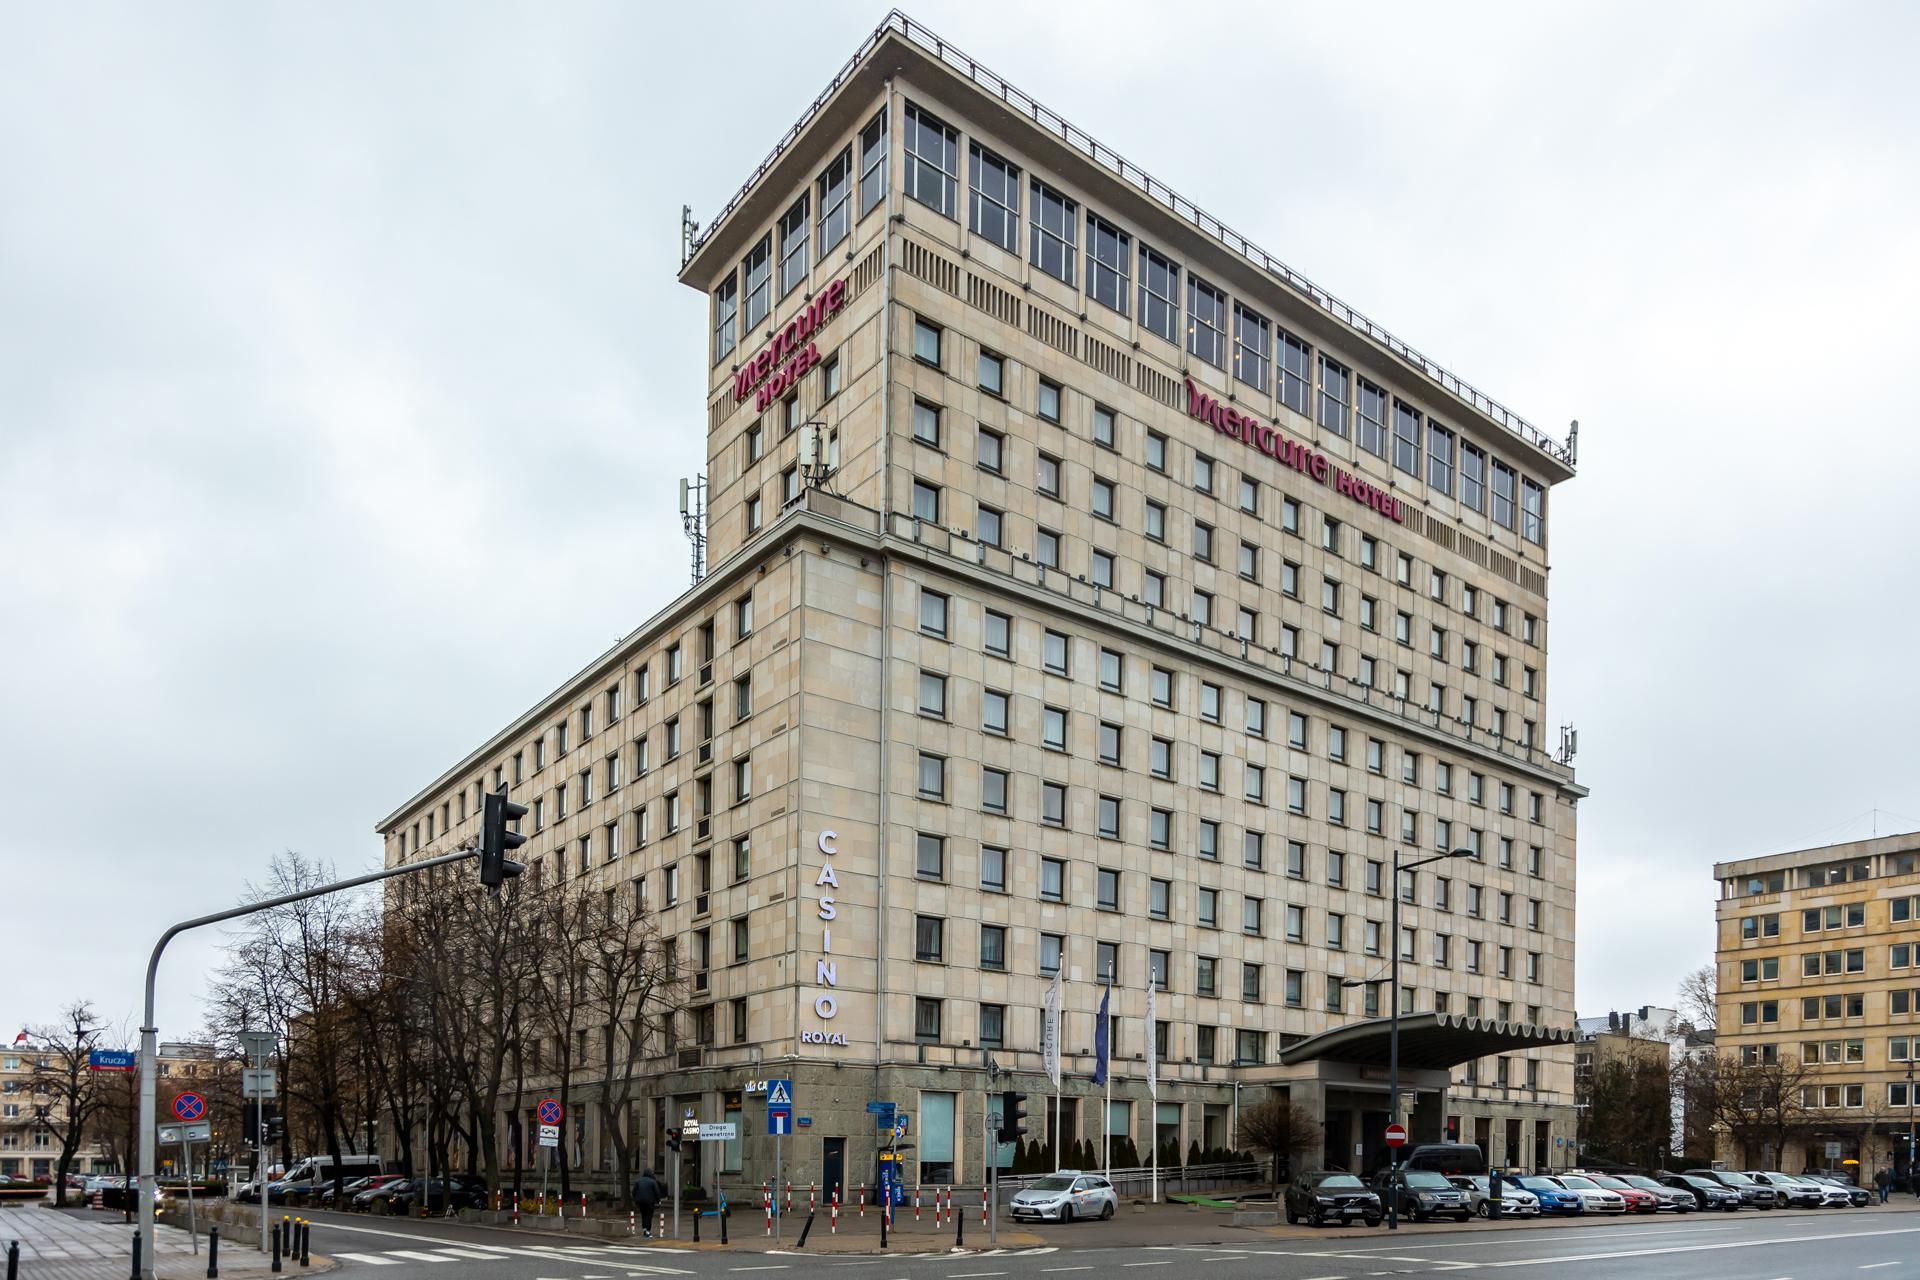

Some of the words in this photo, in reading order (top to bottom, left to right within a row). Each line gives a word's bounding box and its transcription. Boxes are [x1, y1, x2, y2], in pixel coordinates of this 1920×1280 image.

[756, 342, 822, 412] HOTEL
[1336, 468, 1403, 523] HOTEL
[815, 830, 838, 1019] CASINO
[801, 1030, 850, 1046] ROYAL
[99, 1055, 126, 1065] Krucza
[683, 1127, 700, 1135] CASINO
[684, 1119, 698, 1127] ROYAL
